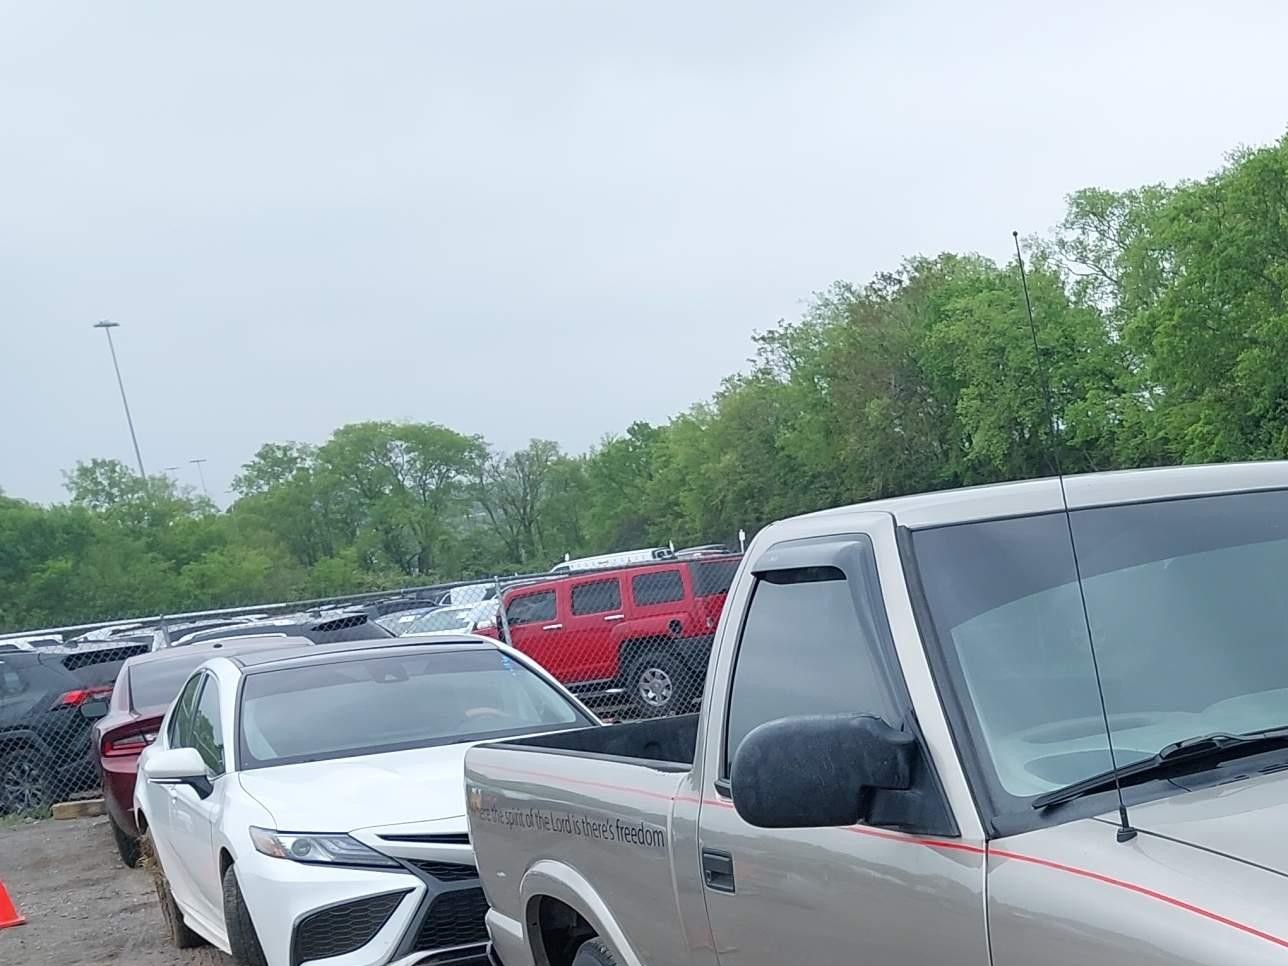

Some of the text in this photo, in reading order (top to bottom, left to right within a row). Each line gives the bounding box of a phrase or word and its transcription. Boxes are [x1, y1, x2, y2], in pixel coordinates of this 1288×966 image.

[504, 808, 525, 830] spirit
[526, 808, 534, 828] of
[535, 809, 550, 832] the
[551, 812, 572, 834] Lord
[572, 815, 581, 835] is
[581, 816, 614, 841] there's
[616, 819, 665, 848] freedom
